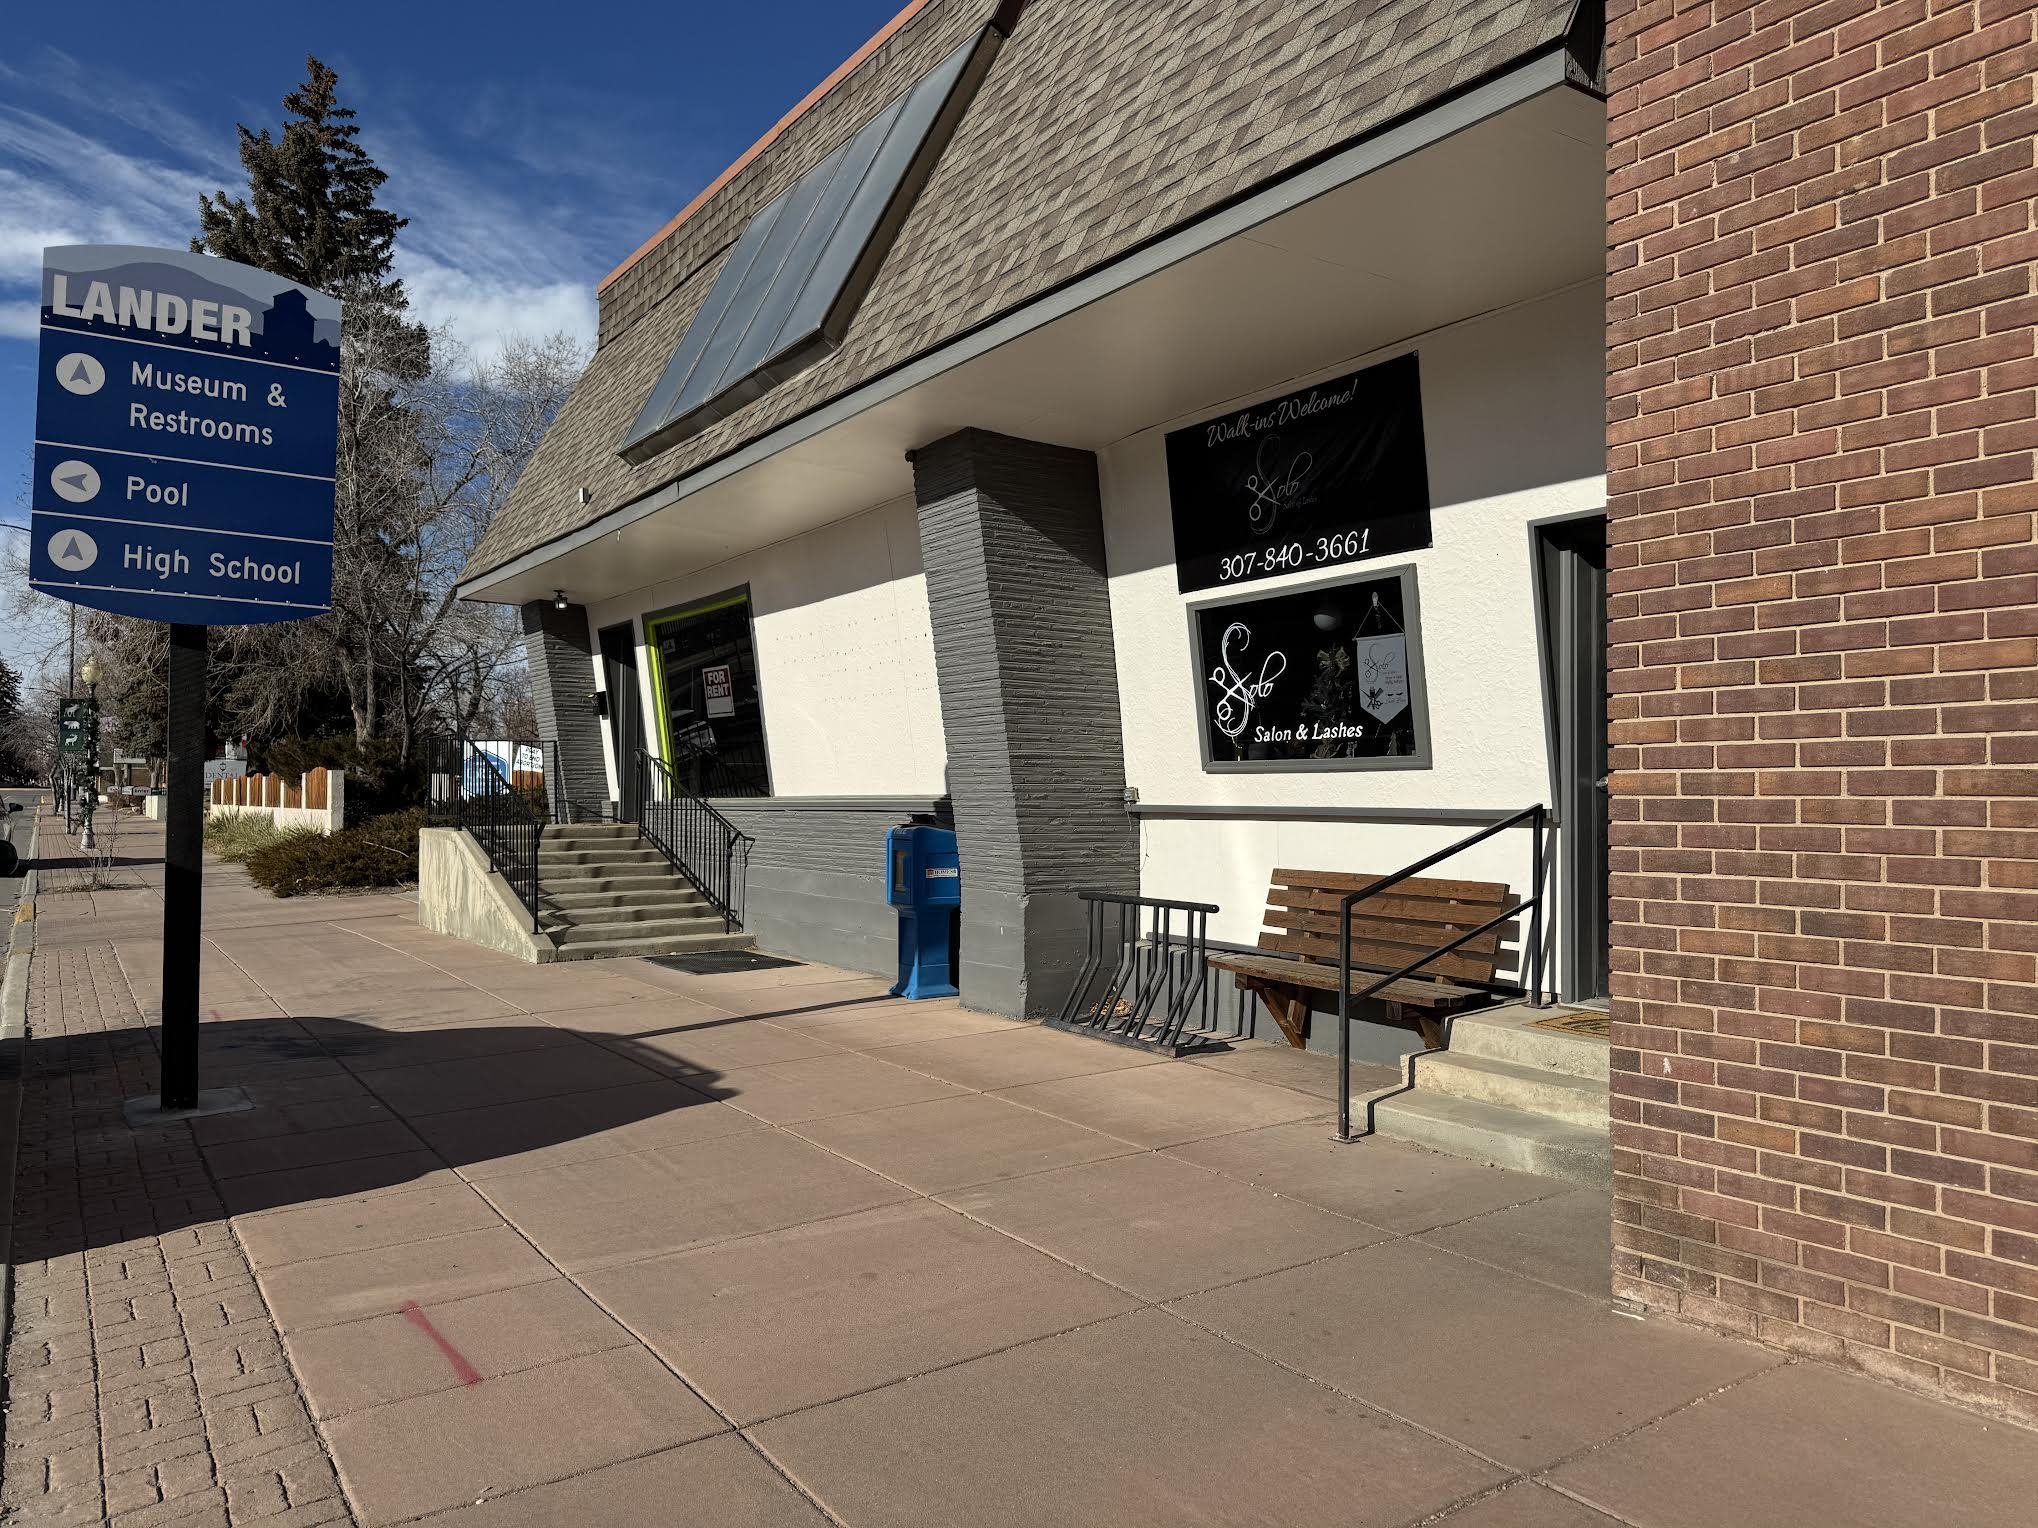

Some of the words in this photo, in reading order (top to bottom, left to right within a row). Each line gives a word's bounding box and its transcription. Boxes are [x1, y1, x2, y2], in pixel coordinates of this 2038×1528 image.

[52, 274, 251, 347] LANDER
[131, 360, 247, 402] Museum
[267, 383, 288, 408] &
[129, 403, 274, 446] Restrooms
[1207, 410, 1275, 448] Walk-ins
[1277, 378, 1358, 426] Welcome!
[126, 476, 188, 507] Pool
[123, 543, 190, 580] High
[209, 552, 300, 585] School
[1219, 528, 1370, 580] 307-840-3661
[706, 683, 729, 698] RENT
[707, 670, 726, 685] FOR
[1254, 725, 1292, 743] Salon
[1295, 723, 1308, 740] &
[1312, 722, 1363, 740] Lashes
[516, 758, 543, 769] ABORION
